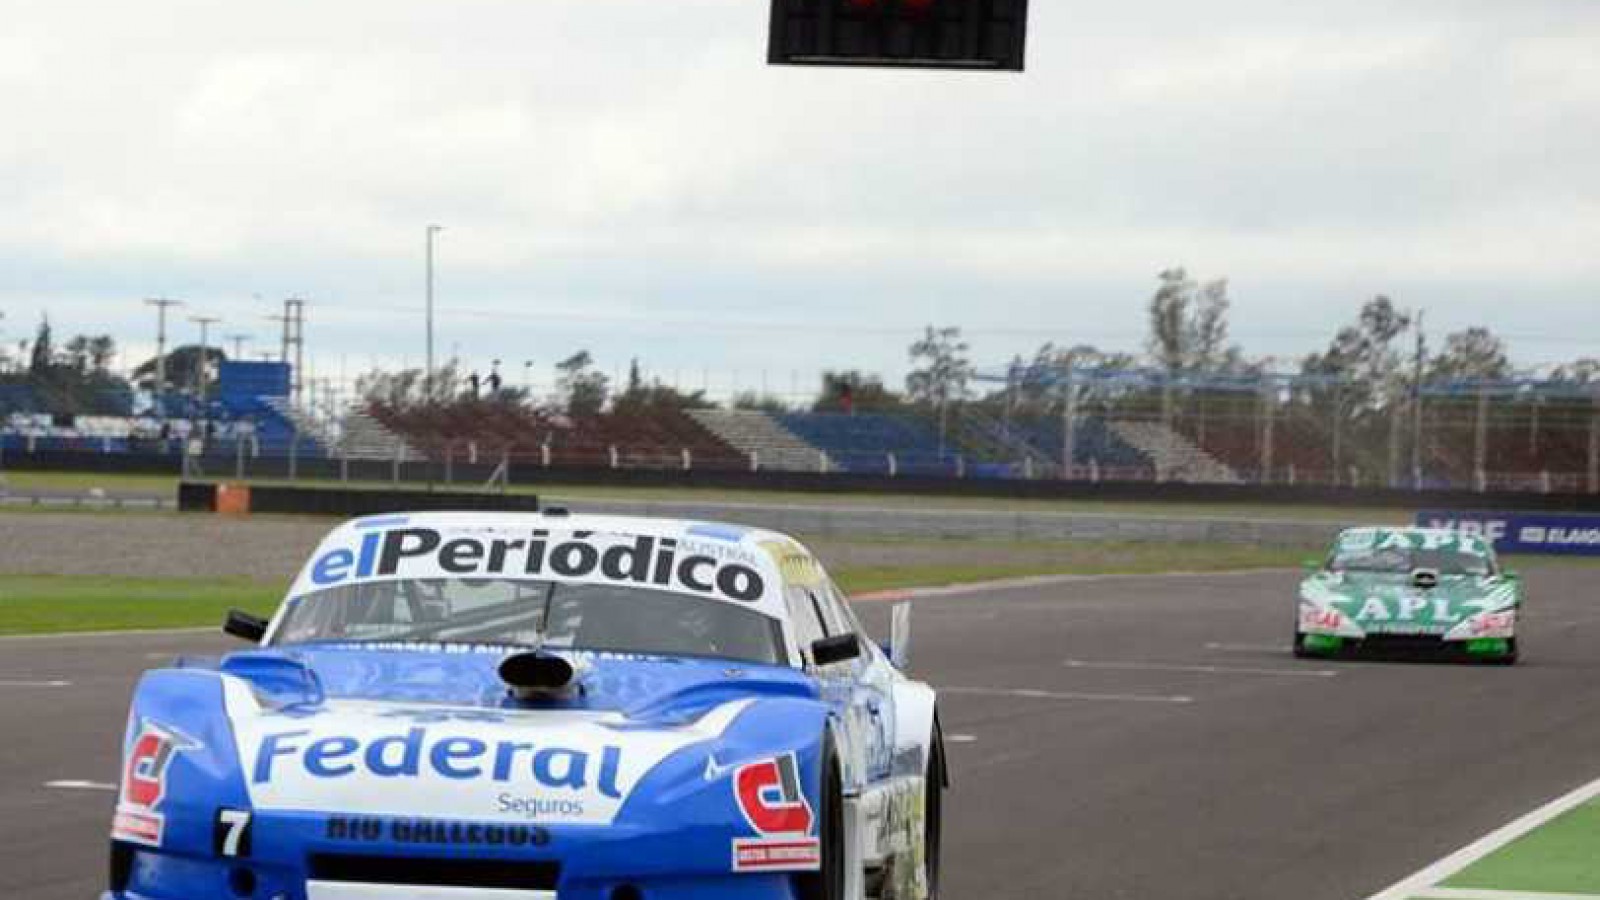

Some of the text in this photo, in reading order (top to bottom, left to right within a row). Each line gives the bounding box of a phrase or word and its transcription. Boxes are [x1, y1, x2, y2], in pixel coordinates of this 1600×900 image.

[311, 527, 764, 601] elPeriódico
[1355, 597, 1461, 621] APL
[253, 727, 623, 798] Federal
[497, 792, 584, 817] Seguros
[220, 811, 249, 855] 7
